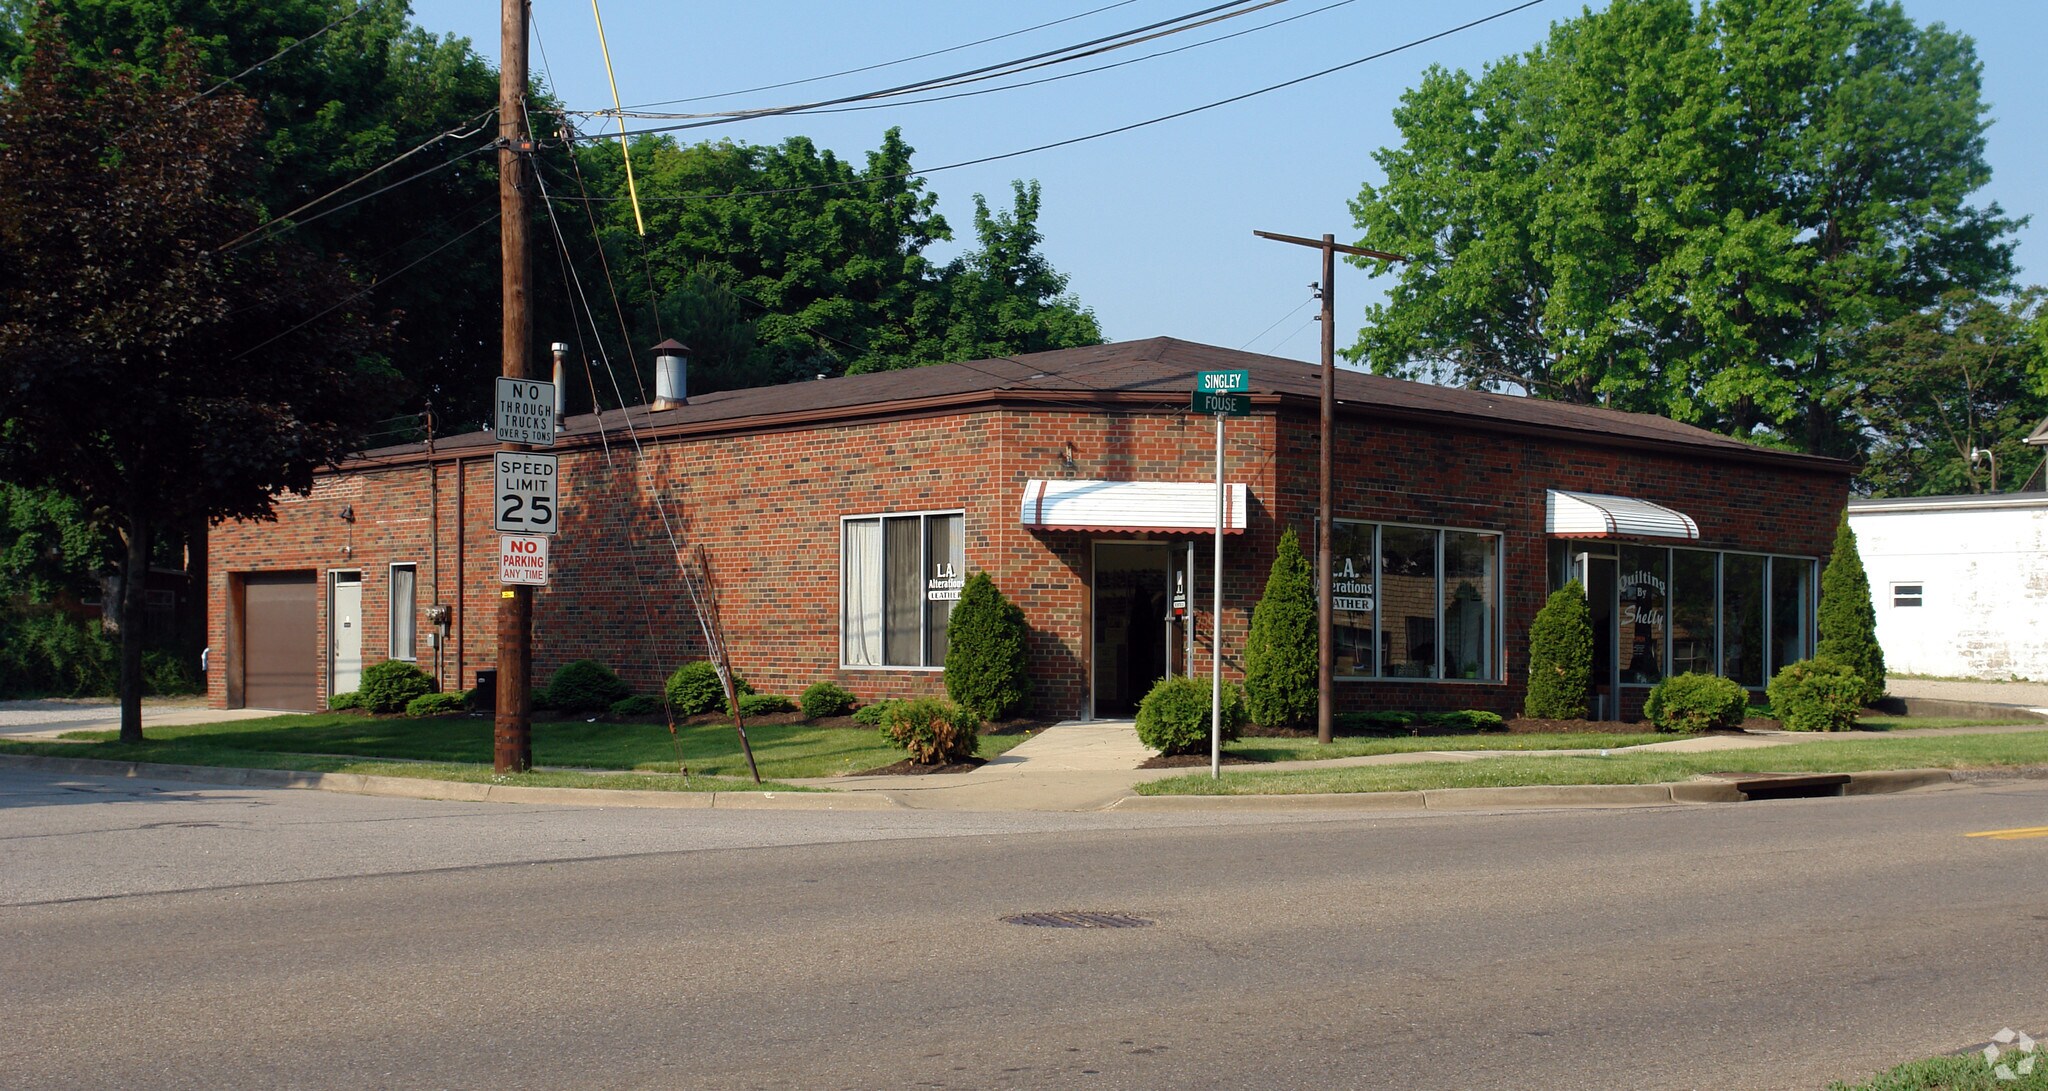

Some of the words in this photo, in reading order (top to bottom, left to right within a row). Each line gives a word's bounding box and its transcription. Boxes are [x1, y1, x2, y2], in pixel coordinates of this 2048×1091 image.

[1204, 373, 1241, 389] SINGLEY
[512, 383, 539, 400] NO
[500, 400, 551, 417] THROUGH
[1205, 395, 1237, 412] FOUSE
[505, 414, 547, 430] TRUCKS
[499, 427, 519, 439] OVER
[521, 429, 529, 440] 5
[532, 431, 551, 442] TONS
[501, 461, 553, 476] SPEED
[506, 478, 548, 492] LIMIT
[501, 494, 552, 525] 25
[510, 540, 538, 554] NO
[503, 554, 545, 569] PARKING
[1332, 557, 1361, 578] .A.
[503, 568, 521, 579] ANY
[524, 569, 544, 580] TIME
[1315, 579, 1373, 595] erations
[1619, 569, 1666, 597] Quilting
[1636, 586, 1647, 599] By
[1332, 597, 1370, 610] ATHER
[1620, 604, 1664, 631] Shelly
